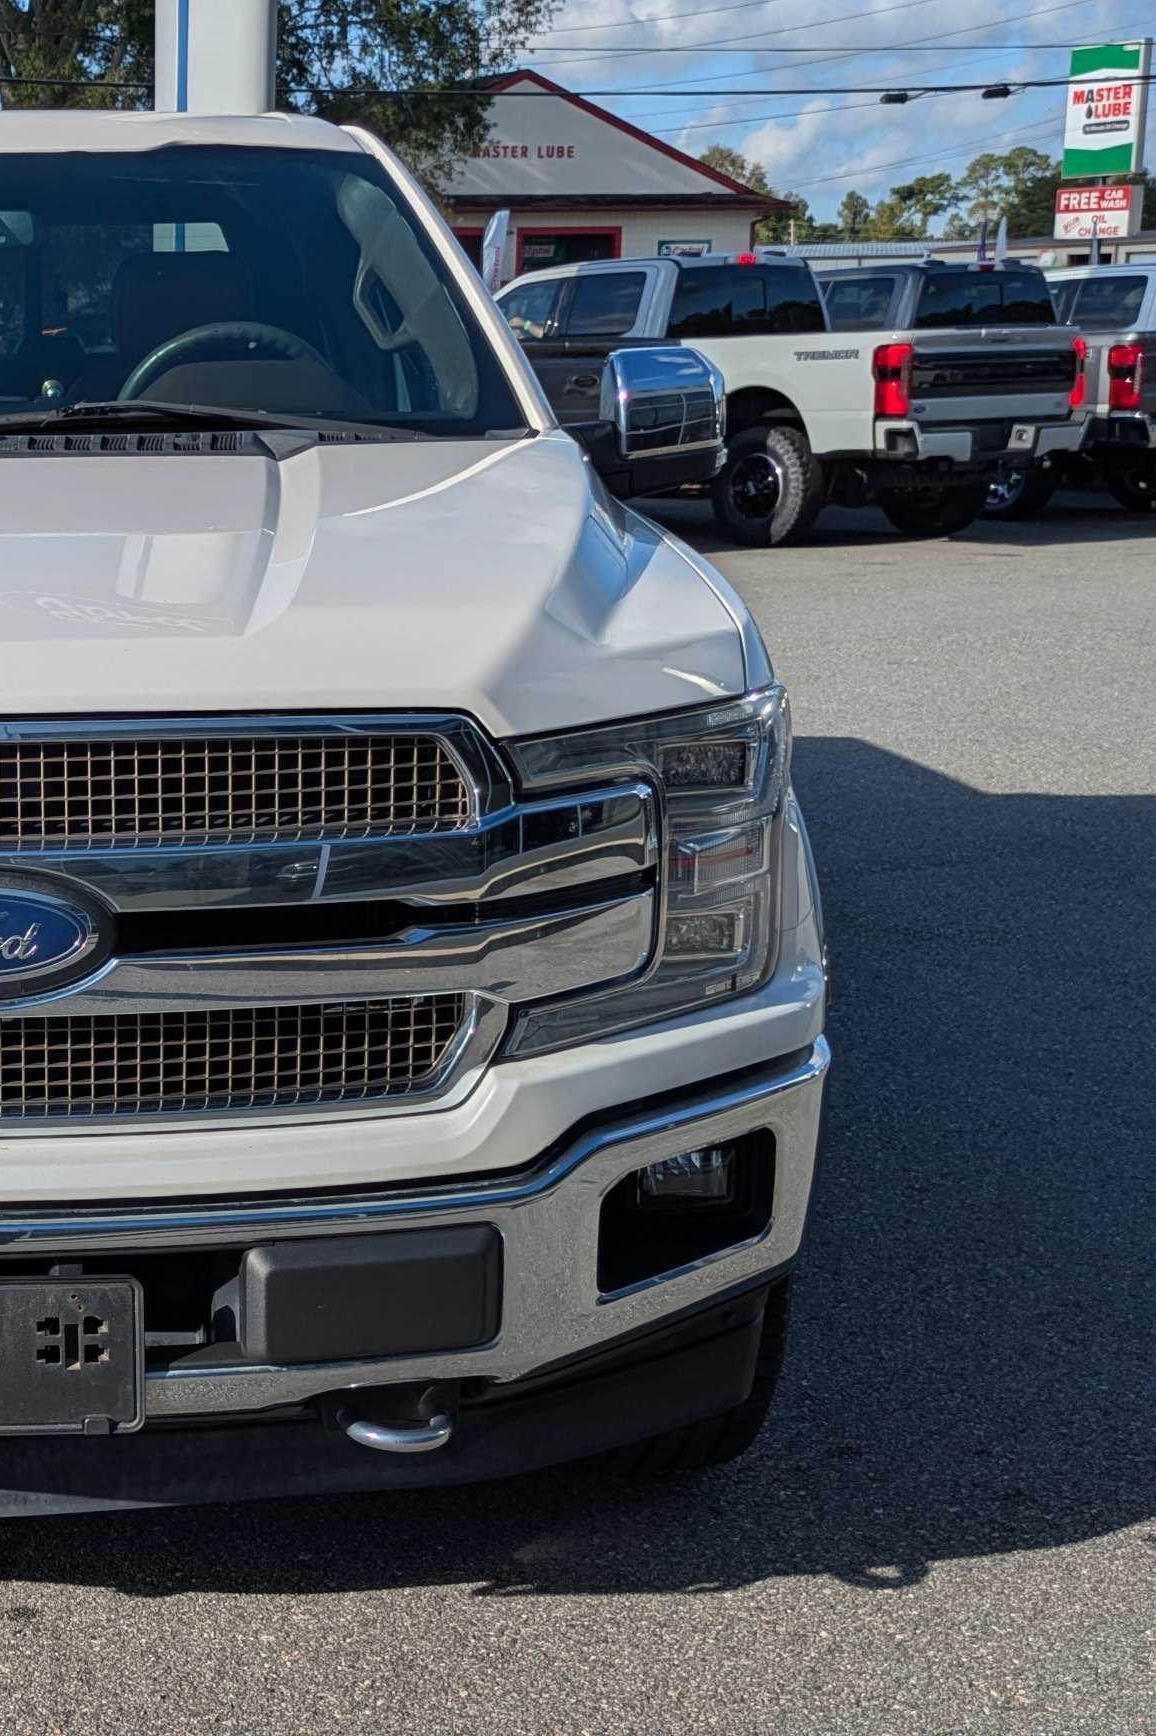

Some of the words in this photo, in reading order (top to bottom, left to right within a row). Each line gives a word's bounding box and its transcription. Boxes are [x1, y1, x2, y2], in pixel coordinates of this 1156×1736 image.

[1073, 84, 1132, 105] MASTER
[1094, 102, 1132, 118] LUBE
[537, 145, 575, 159] LUBE
[1105, 189, 1124, 199] CAR
[1059, 191, 1100, 211] FREE
[1100, 199, 1127, 209] WASH
[1091, 214, 1107, 224] OIL
[794, 349, 860, 362] TREMOR
